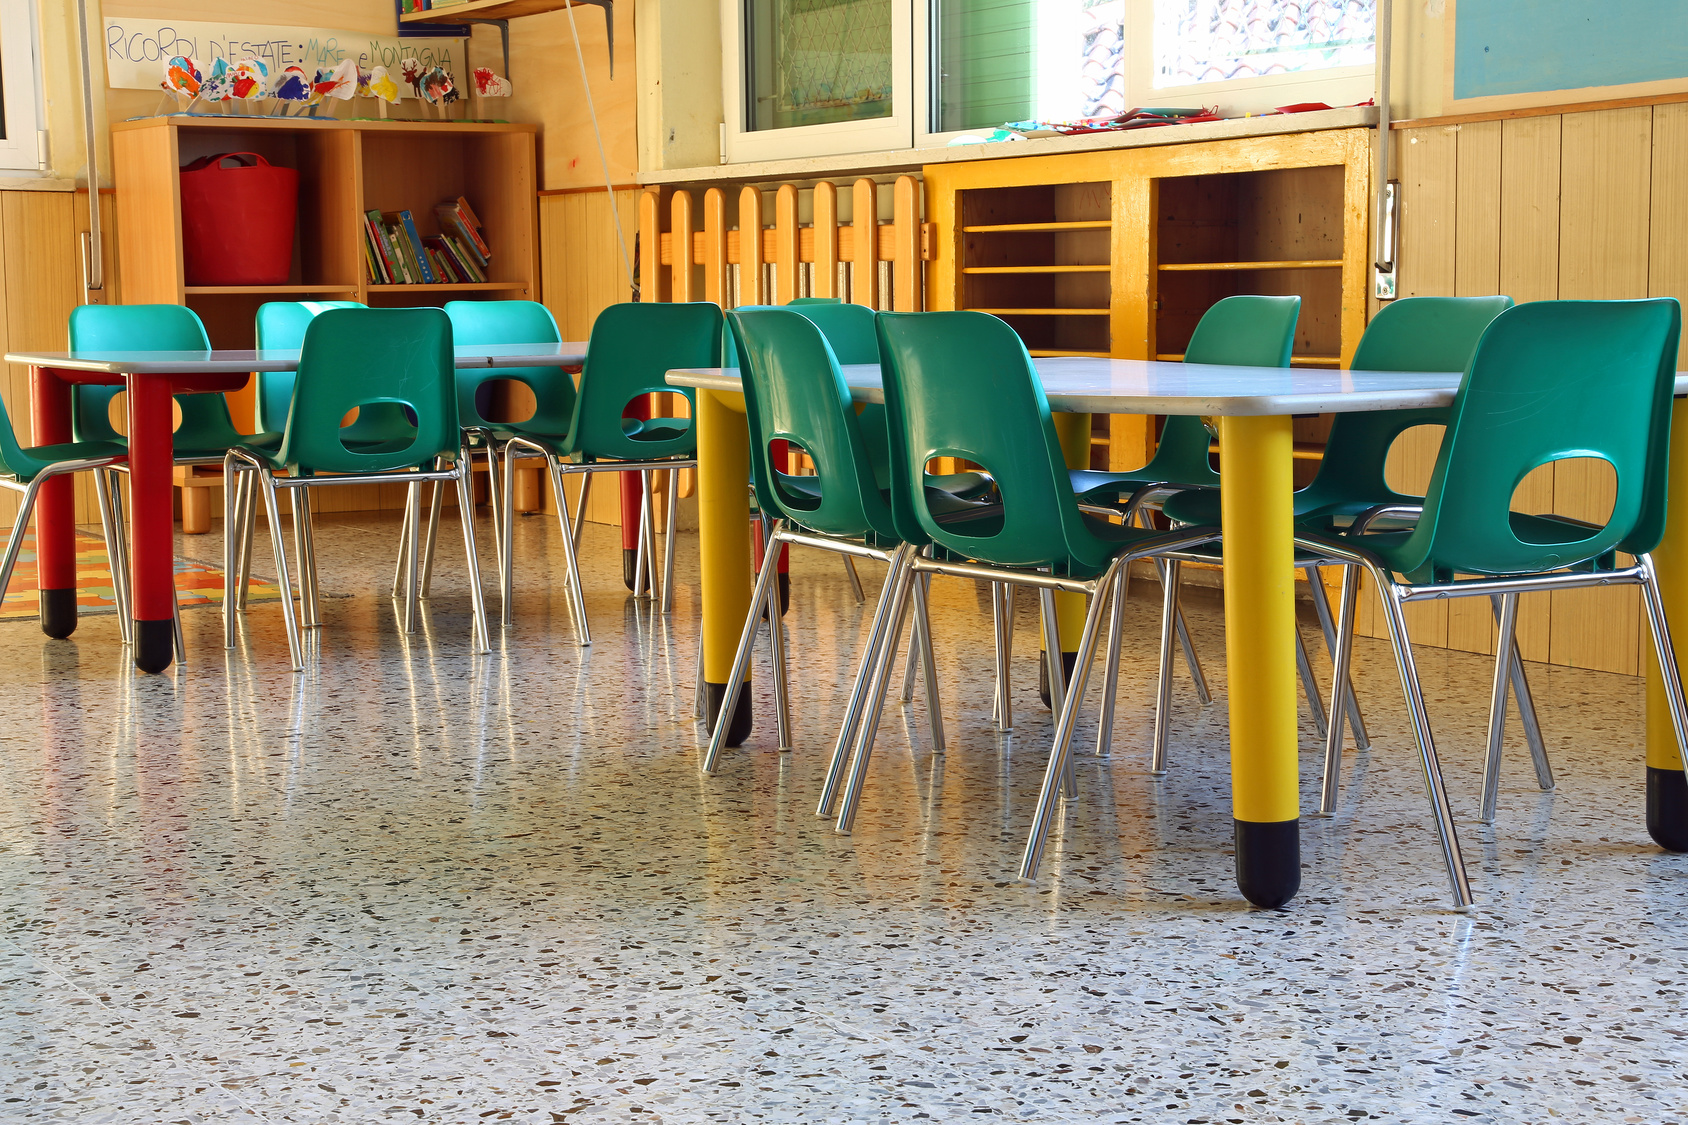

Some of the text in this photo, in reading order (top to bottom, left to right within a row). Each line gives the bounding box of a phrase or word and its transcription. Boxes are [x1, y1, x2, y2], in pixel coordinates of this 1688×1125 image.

[106, 25, 198, 62] RICORDI
[304, 37, 346, 66] MARE
[369, 40, 452, 71] MONTAGNA
